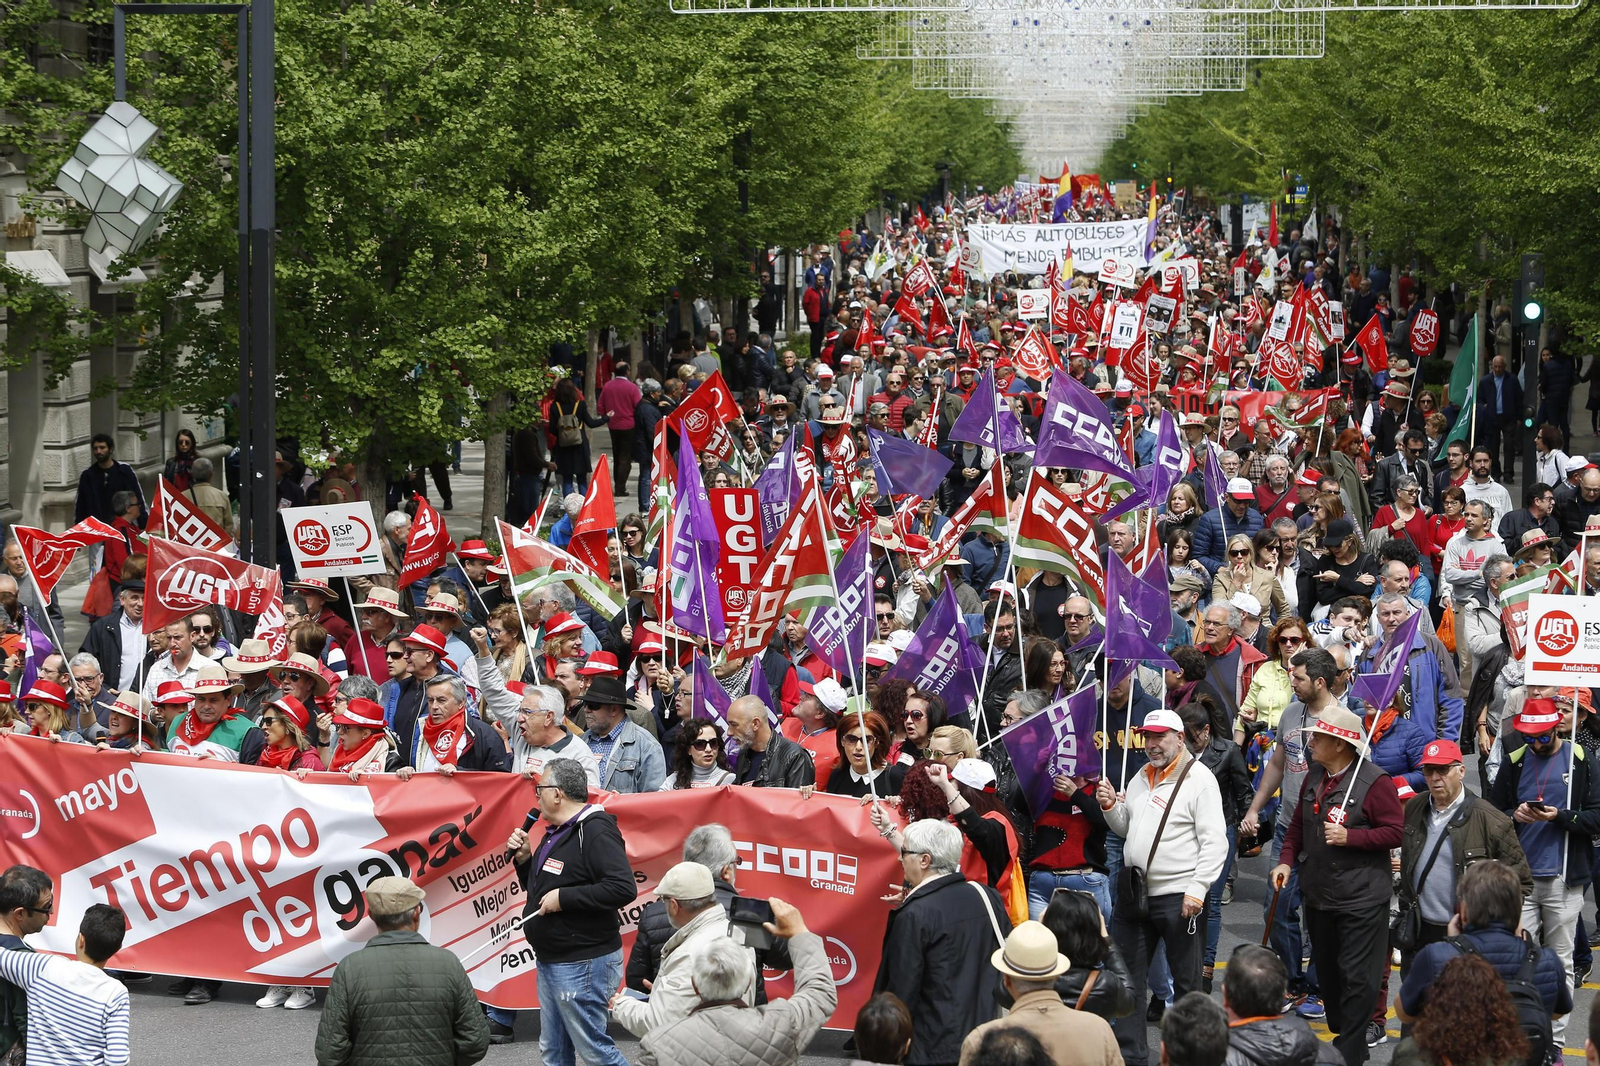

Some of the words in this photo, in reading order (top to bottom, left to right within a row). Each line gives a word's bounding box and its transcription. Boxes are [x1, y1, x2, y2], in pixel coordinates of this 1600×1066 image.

[1035, 226, 1125, 242] AUTOBUSES
[1133, 223, 1143, 239] Y
[1004, 249, 1056, 264] MENOS
[1415, 312, 1437, 334] UGT
[297, 524, 326, 539] UGT
[723, 494, 759, 584] UGT
[324, 558, 354, 567] Andalucía
[167, 567, 230, 605] UGT
[1541, 617, 1574, 636] UGT
[1561, 663, 1598, 673] Andalucía
[54, 767, 140, 822] mayo
[0, 808, 34, 819] ranada
[90, 807, 320, 931] Tiempo
[323, 805, 484, 932] ganar
[810, 878, 855, 895] Granada
[472, 886, 511, 918] Mejor
[510, 879, 527, 896] e
[242, 892, 313, 953] de
[501, 946, 537, 973] Pen
